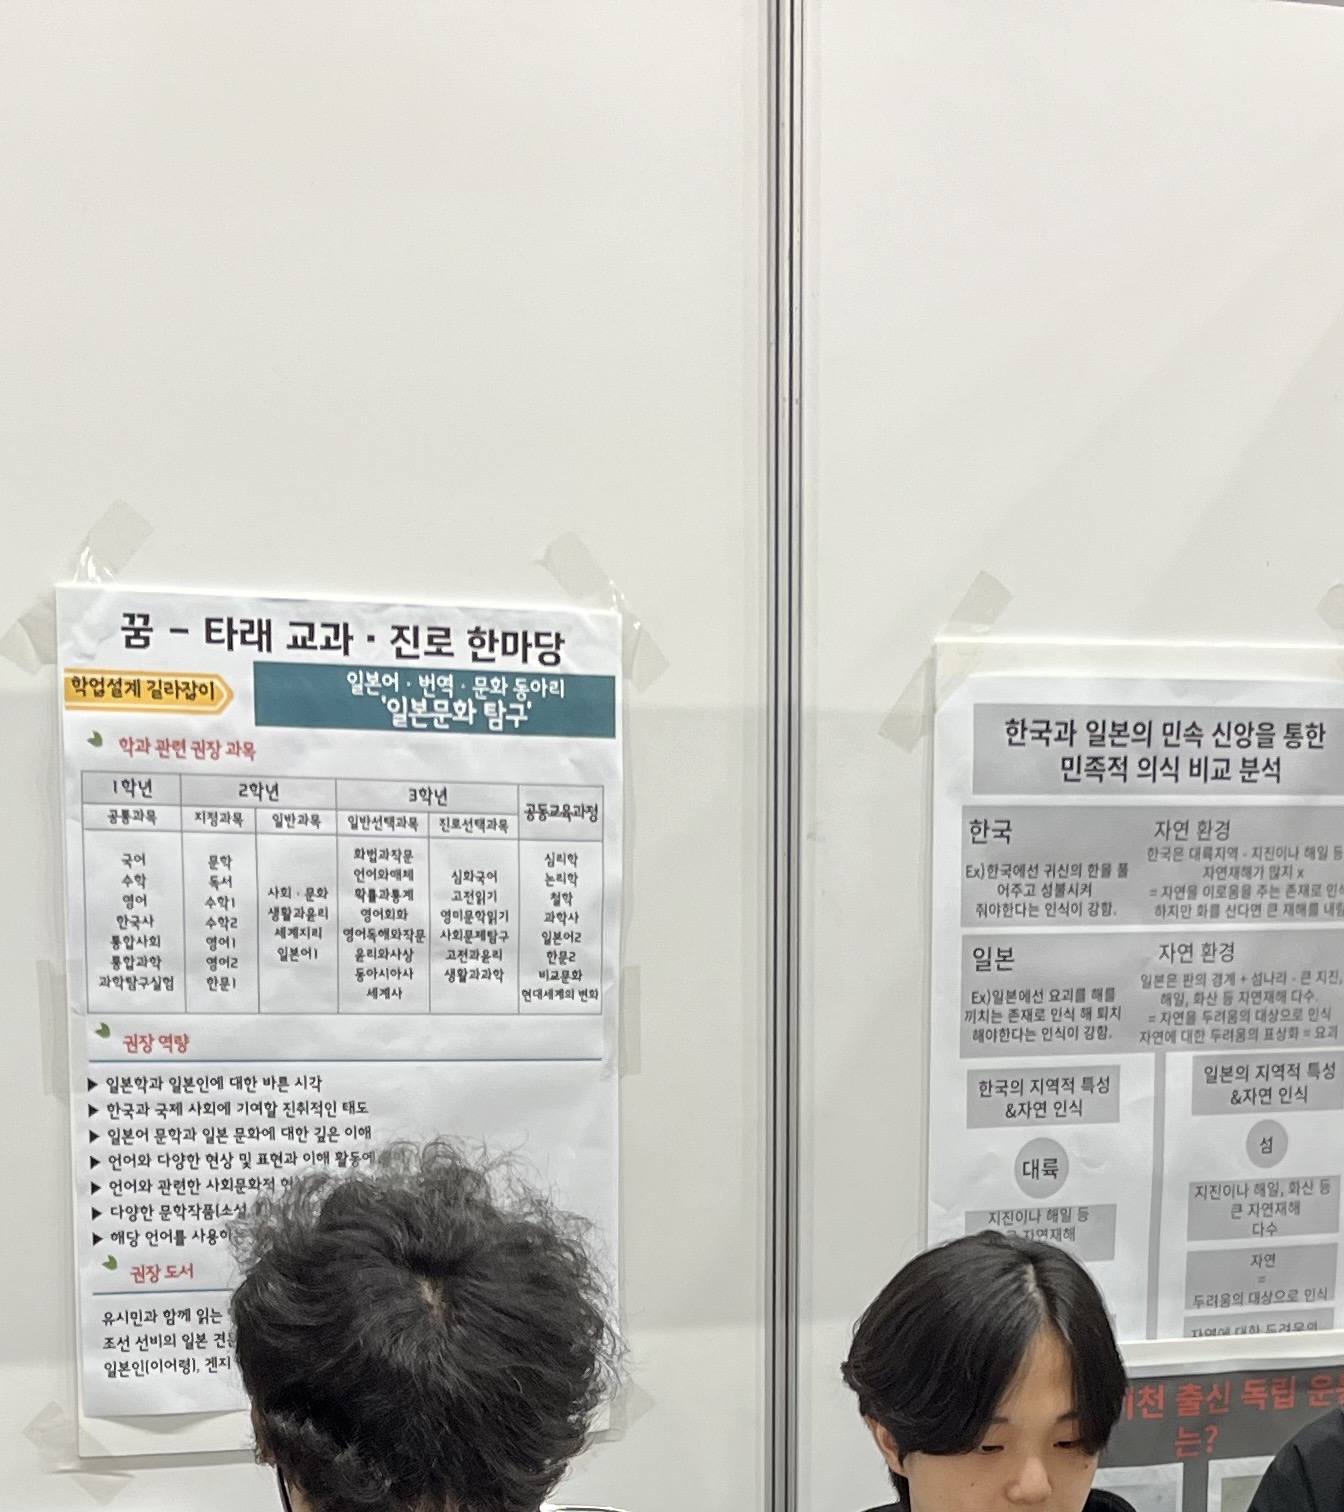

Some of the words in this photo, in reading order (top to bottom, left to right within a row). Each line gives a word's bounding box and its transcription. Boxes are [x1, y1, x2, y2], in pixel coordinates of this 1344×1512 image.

[120, 612, 154, 650] 꿈
[204, 616, 272, 654] 타래
[286, 620, 354, 657] 교과
[389, 624, 455, 660] 진로
[466, 625, 566, 667] 한마당
[70, 675, 141, 699] 학업설계
[146, 678, 215, 702] 길라잡이
[346, 669, 399, 700] 일본어
[418, 672, 454, 699] 번역
[471, 675, 509, 701] 문화
[512, 677, 565, 702] 동아리
[1005, 717, 1078, 748] 한국과
[1085, 719, 1153, 749] 일본의
[1162, 720, 1204, 749] 민속
[1211, 720, 1276, 749] 신앙을
[1283, 721, 1327, 750] 통한
[118, 735, 150, 758] 학과
[155, 736, 187, 759] 관련
[191, 738, 221, 760] 권장
[225, 739, 257, 761] 과목
[1061, 754, 1128, 784] 민족적
[1136, 755, 1180, 784] 의식
[1189, 755, 1232, 784] 비교
[1238, 755, 1281, 784] 분석
[112, 777, 153, 799] 1학년
[238, 781, 279, 803] 2학년
[408, 786, 448, 807] 3학년
[107, 808, 157, 826] 공통과목
[194, 810, 244, 828] 지정과목
[271, 812, 322, 830] 일반과목
[347, 813, 419, 833] 일반선택과목
[523, 802, 599, 823] 공동교육과정
[439, 816, 509, 834] 진로선택과목
[969, 818, 1012, 845] 한국
[1153, 819, 1190, 842] 자연
[1196, 819, 1231, 842] 환경
[121, 852, 146, 869] 국어
[207, 854, 233, 871] 문학
[544, 851, 579, 869] 심리학
[121, 873, 147, 890] 수학
[544, 871, 579, 888] 논리학
[122, 893, 148, 911] 영어
[1044, 900, 1083, 918] 인식이
[115, 913, 155, 931] 한국사
[205, 915, 238, 932] 수학2
[543, 910, 580, 927] 과학사
[541, 930, 582, 946] 일본어2
[972, 946, 1015, 972] 일본
[1158, 942, 1194, 965] 자연
[1200, 941, 1235, 964] 환경
[1050, 1006, 1076, 1023] 인식
[122, 1033, 154, 1054] 권장
[158, 1032, 190, 1054] 역량
[1041, 1025, 1079, 1042] 인식이
[1204, 1064, 1250, 1085] 일본의
[1255, 1062, 1301, 1082] 지역적
[1306, 1061, 1336, 1081] 특성
[105, 1075, 164, 1095] 일본학과
[168, 1074, 224, 1094] 일본인에
[229, 1075, 258, 1094] 대한
[262, 1074, 290, 1094] 바른
[294, 1074, 323, 1093] 시각
[978, 1077, 1024, 1098] 한국의
[1029, 1076, 1075, 1096] 지역적
[1080, 1075, 1110, 1095] 특성
[1230, 1086, 1273, 1106] &자연
[1278, 1085, 1308, 1105] 인식
[106, 1101, 151, 1121] 한국과
[154, 1101, 183, 1120] 국제
[188, 1100, 231, 1117] 사회에
[236, 1100, 278, 1119] 기여할
[282, 1099, 337, 1119] 진취적인
[341, 1099, 369, 1115] 태도
[1005, 1100, 1047, 1120] &자연
[1053, 1098, 1083, 1118] 인식
[107, 1126, 149, 1146] 일본어
[153, 1126, 198, 1146] 문학과
[201, 1125, 229, 1145] 일본
[233, 1125, 276, 1145] 문화에
[280, 1125, 310, 1144] 대한
[313, 1125, 341, 1144] 깊은
[344, 1124, 372, 1141] 이해
[1259, 1136, 1273, 1155] 섬
[108, 1152, 152, 1172] 언어와
[157, 1151, 201, 1171] 다양한
[205, 1151, 234, 1171] 현상
[238, 1151, 252, 1170] 및
[256, 1150, 298, 1169] 표현과
[302, 1150, 330, 1166] 이해
[1022, 1157, 1059, 1181] 대륙
[109, 1178, 154, 1197] 언어와
[157, 1177, 202, 1197] 관련한
[205, 1175, 276, 1195] 사회문화적
[1194, 1182, 1250, 1201] 지진이나
[110, 1203, 155, 1223] 다양한
[987, 1208, 1042, 1227] 지진이나
[110, 1229, 141, 1248] 해당
[144, 1228, 187, 1248] 언어를
[1251, 1221, 1279, 1238] 다수
[1250, 1252, 1276, 1269] 자연
[130, 1264, 161, 1284] 권장
[164, 1263, 194, 1279] 도서
[1303, 1285, 1328, 1303] 인식
[101, 1308, 159, 1328] 유시민과
[162, 1307, 191, 1326] 함께
[196, 1306, 223, 1325] 읽는
[102, 1334, 130, 1353] 조선
[135, 1332, 177, 1352] 선비의
[181, 1331, 209, 1351] 일본
[205, 1355, 231, 1374] 겐지
[1177, 1381, 1231, 1418] 출신
[1242, 1376, 1297, 1410] 독립
[1175, 1424, 1219, 1457] 는?
